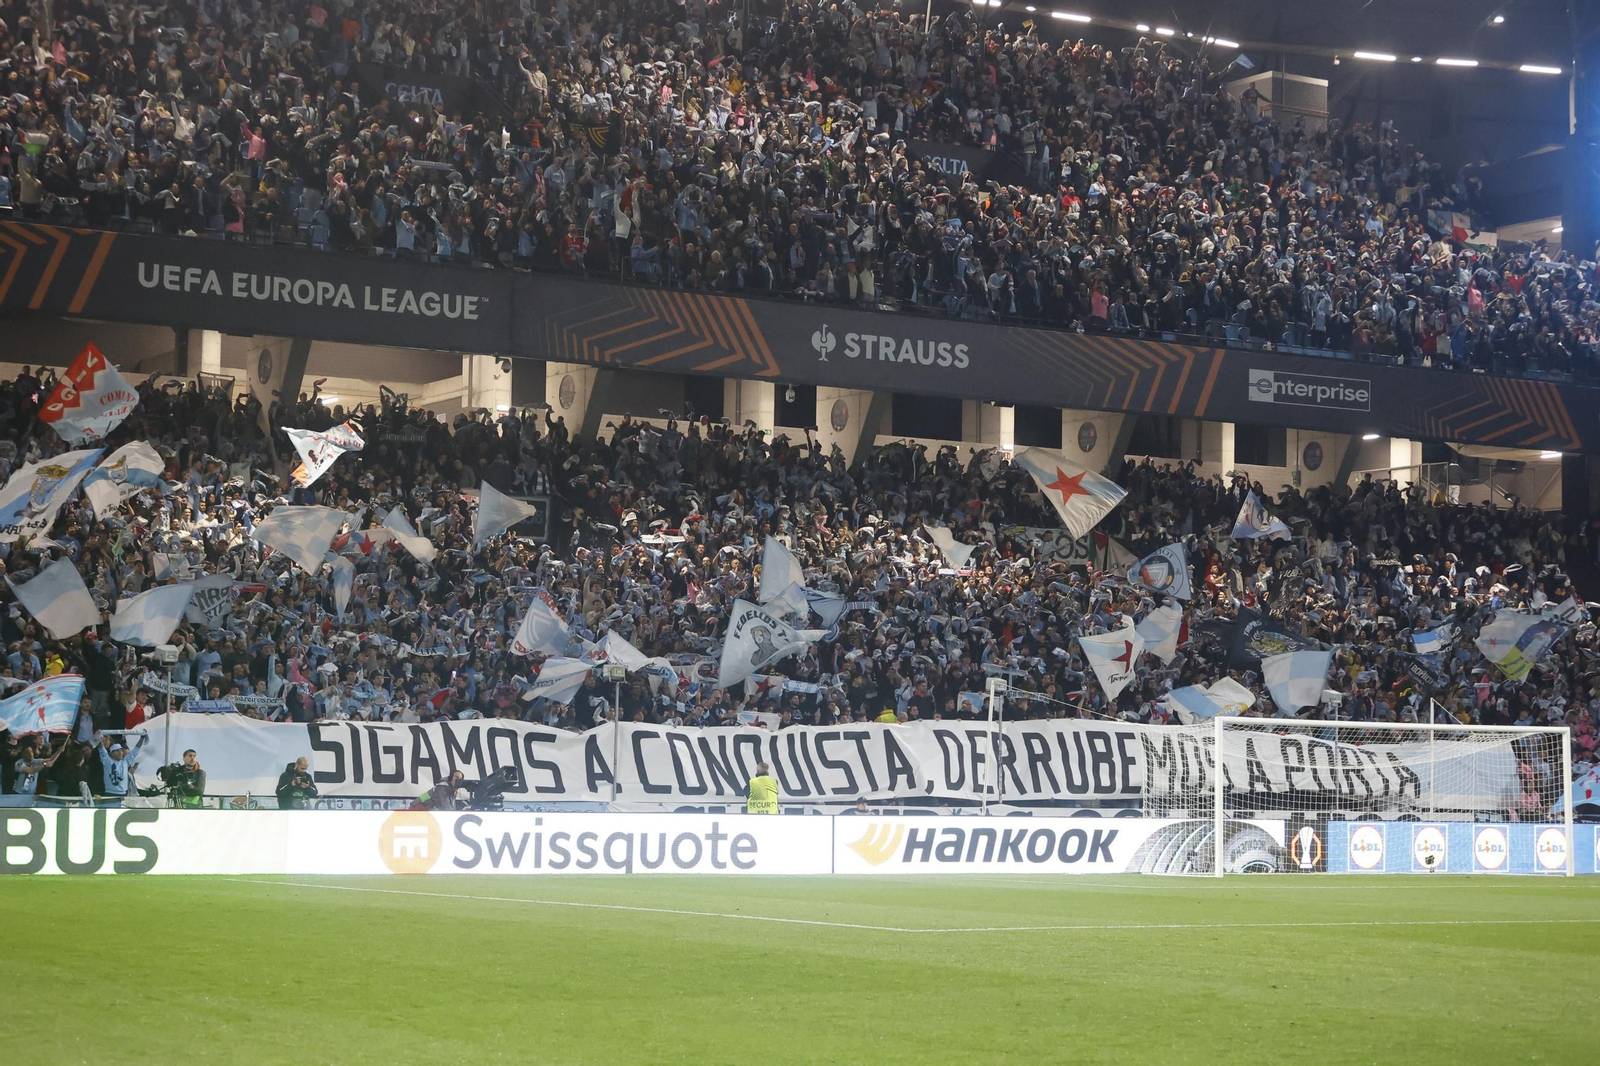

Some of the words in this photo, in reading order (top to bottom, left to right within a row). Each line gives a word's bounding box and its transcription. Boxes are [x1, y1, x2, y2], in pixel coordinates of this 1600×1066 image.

[138, 262, 223, 296] UEFA
[232, 272, 355, 309] EUROPA
[364, 285, 479, 320] LEAGUE
[844, 332, 970, 368] STRAUSS
[1255, 378, 1370, 403] enterprise
[307, 722, 565, 794] SIGAMOS
[585, 734, 622, 794] A
[933, 729, 1235, 796] DERRUBEMOS
[1246, 738, 1273, 792] A
[1280, 738, 1421, 799] PORTA
[452, 814, 758, 874] Swissquote
